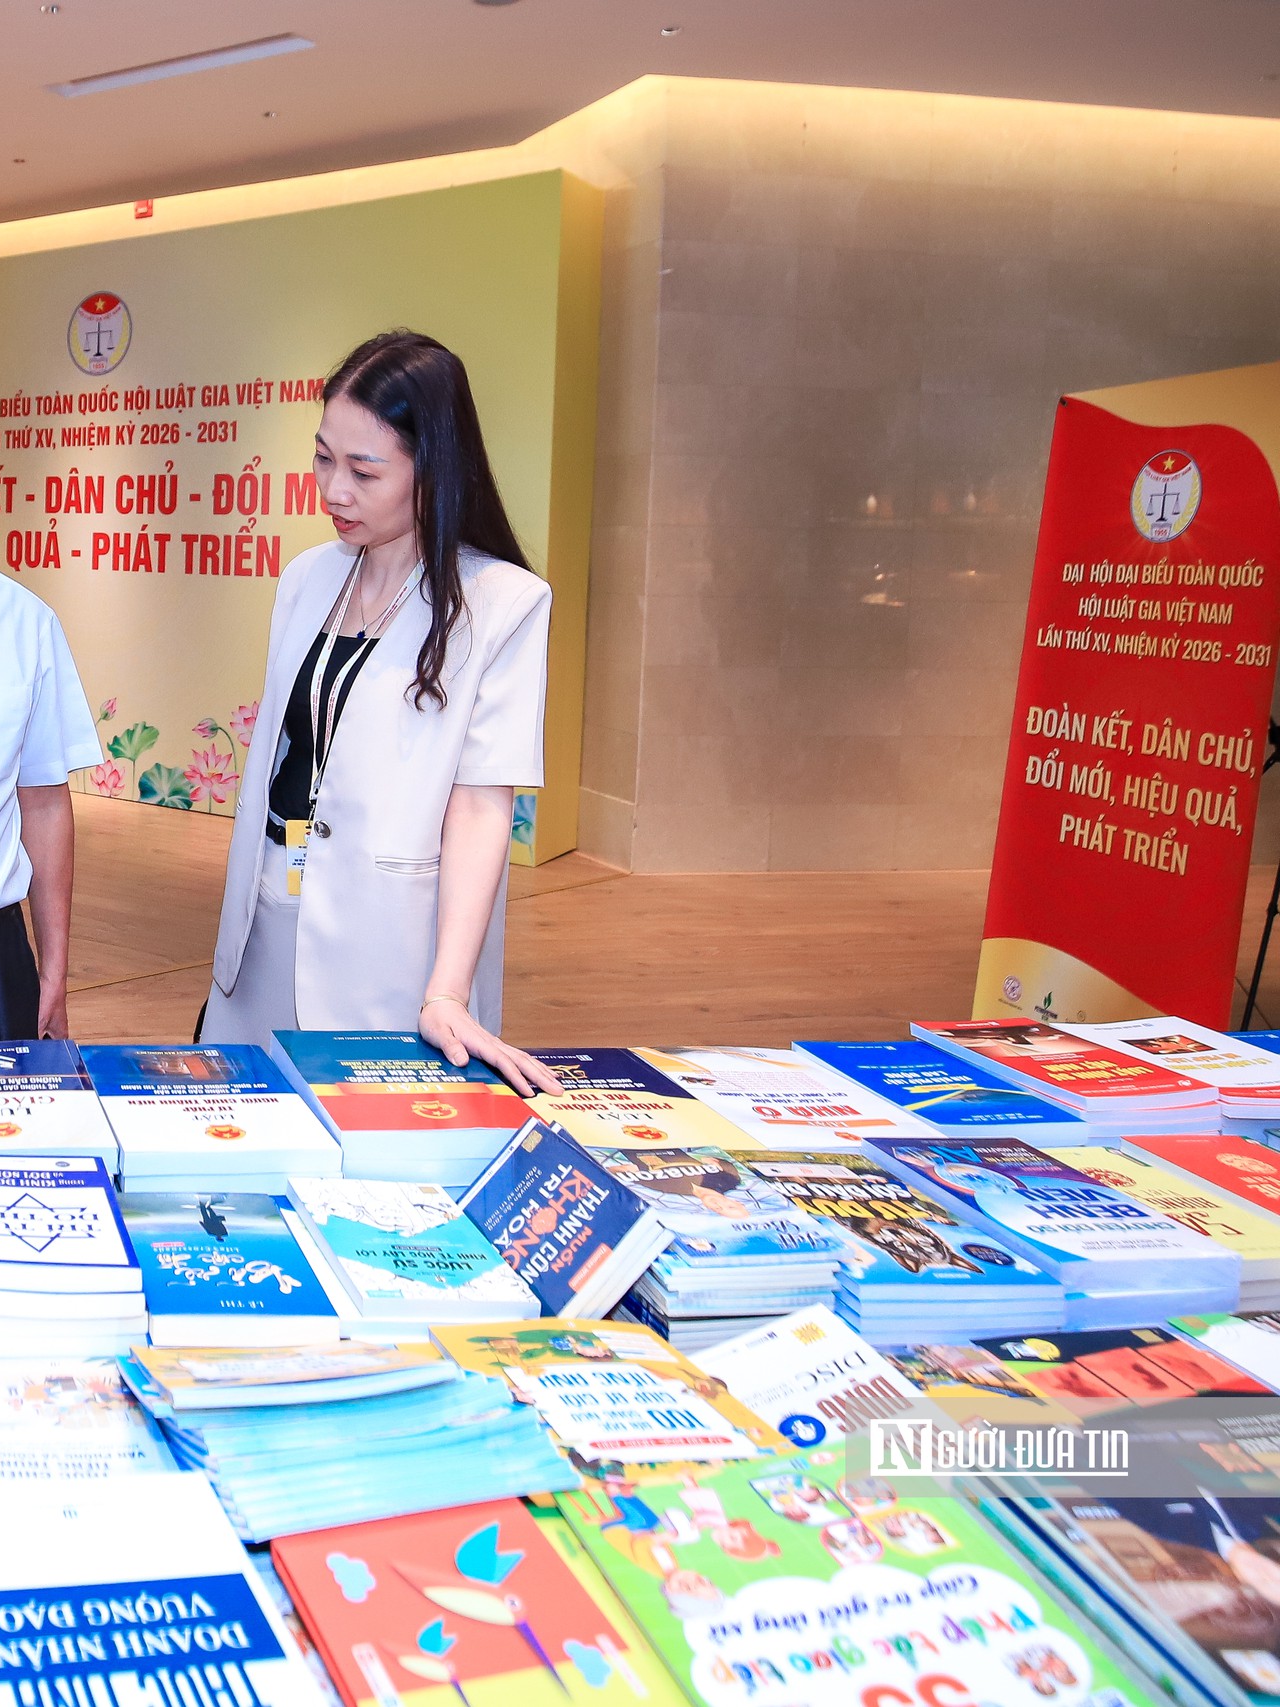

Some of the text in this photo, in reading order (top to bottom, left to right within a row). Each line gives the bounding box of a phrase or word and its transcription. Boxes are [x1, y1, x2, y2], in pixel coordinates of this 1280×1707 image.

[0, 390, 31, 418] BIỂU
[35, 388, 73, 417] TOÀN
[77, 384, 119, 417] QUỐC
[123, 384, 151, 416] HỘI
[155, 383, 197, 413] LUẬT
[200, 383, 230, 409] GIA
[235, 378, 274, 409] VIỆT
[5, 425, 33, 450] THỨ
[35, 427, 56, 450] XV,
[60, 423, 111, 451] NHIỆM
[114, 420, 136, 446] KỲ
[139, 420, 180, 445] 2026
[196, 419, 238, 443] 2031
[44, 466, 104, 515] DÂN
[115, 459, 177, 517] CHỦ
[211, 455, 271, 516] ĐỔI
[5, 518, 61, 572] QUẢ
[91, 522, 171, 574] PHÁT
[180, 516, 281, 579] TRIỂN
[1062, 556, 1265, 589] ĐẠI HỘI ĐẠI BIỂU TOÀN QUỐC
[1078, 593, 1234, 626] HỘI LUẬT GIA VIỆT NAM
[1036, 623, 1064, 650] LẦN
[1065, 626, 1092, 652] THỨ
[1091, 633, 1112, 656] XV,
[1114, 631, 1159, 659] NHIỆM
[1160, 633, 1180, 659] KỲ
[1181, 639, 1222, 664] 2026
[1234, 643, 1272, 668] 2031
[1026, 702, 1257, 779] ĐOÀN KẾT, DÂN CHỦ,
[1025, 747, 1243, 837] ĐỔI MỚI, HIỆU QUẢ,
[1059, 813, 1189, 876] PHÁT TRIỂN
[19, 1178, 56, 1187] KINH
[615, 1163, 721, 1183] amazon
[549, 1225, 593, 1274] MUỐN
[646, 1409, 711, 1431] 100
[81, 1590, 216, 1629] VƯỢNG
[108, 1619, 251, 1660] DOANH
